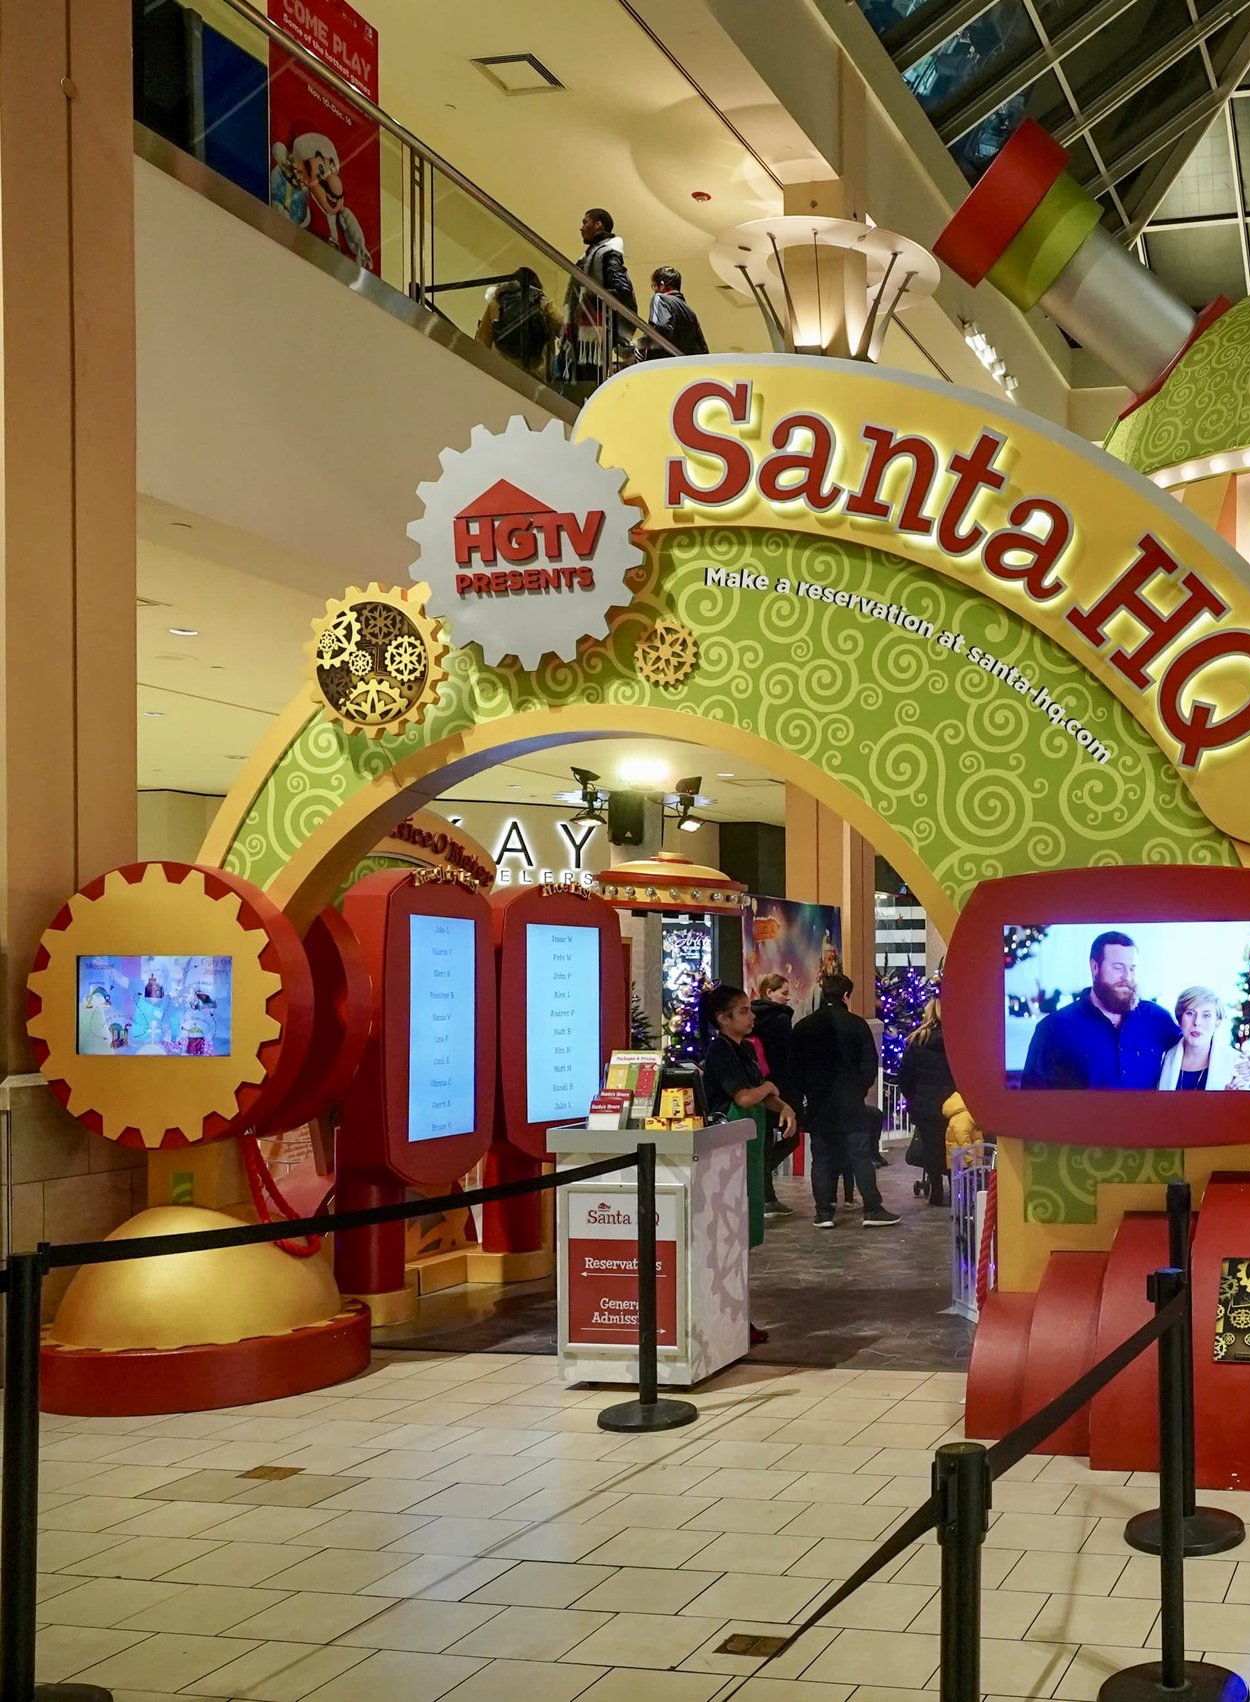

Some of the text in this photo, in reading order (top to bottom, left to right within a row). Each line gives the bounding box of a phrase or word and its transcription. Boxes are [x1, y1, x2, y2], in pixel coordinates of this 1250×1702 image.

[283, 0, 329, 47] COME
[333, 31, 371, 82] PLAY
[283, 13, 303, 36] Some
[304, 33, 312, 43] of
[312, 39, 325, 55] the
[325, 49, 350, 77] hottest
[350, 74, 371, 96] games
[665, 378, 1068, 604] Santa
[453, 510, 605, 563] HGTV
[455, 566, 594, 594] PRESENTS
[704, 567, 1112, 765] Make a reservation at santa-hq.com
[500, 870, 594, 886] ELERS
[587, 1209, 632, 1225] Santa
[584, 1257, 662, 1271] Reservats
